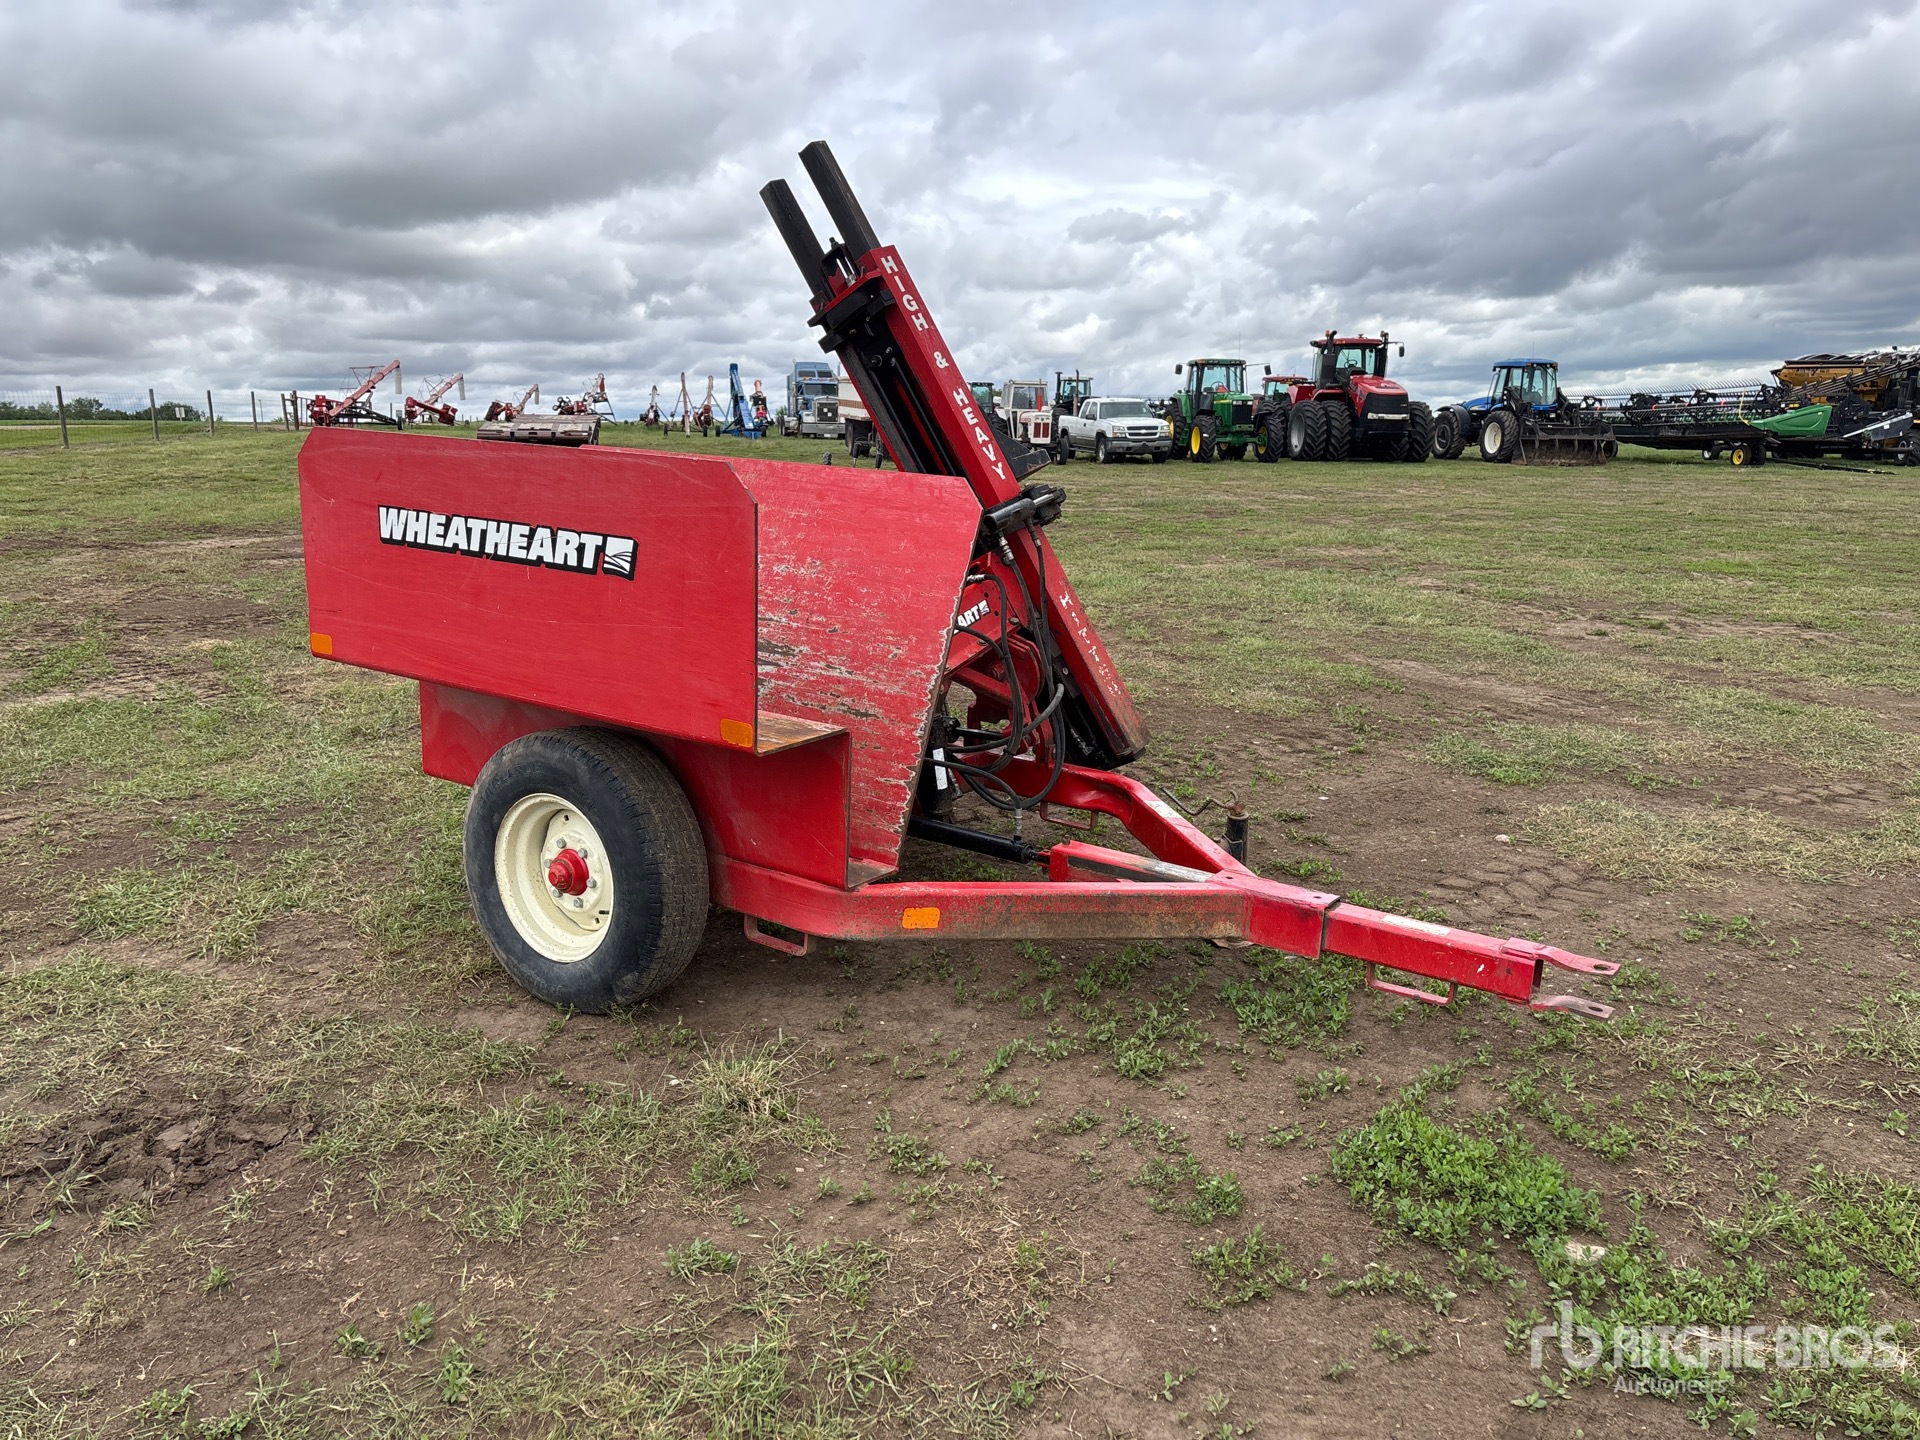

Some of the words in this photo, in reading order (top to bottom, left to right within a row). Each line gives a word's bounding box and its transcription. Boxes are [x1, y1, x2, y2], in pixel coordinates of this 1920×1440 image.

[881, 255, 929, 331] HIGH
[933, 351, 949, 369] &
[952, 388, 1006, 480] HEAVY
[378, 505, 603, 569] WHEATHEART
